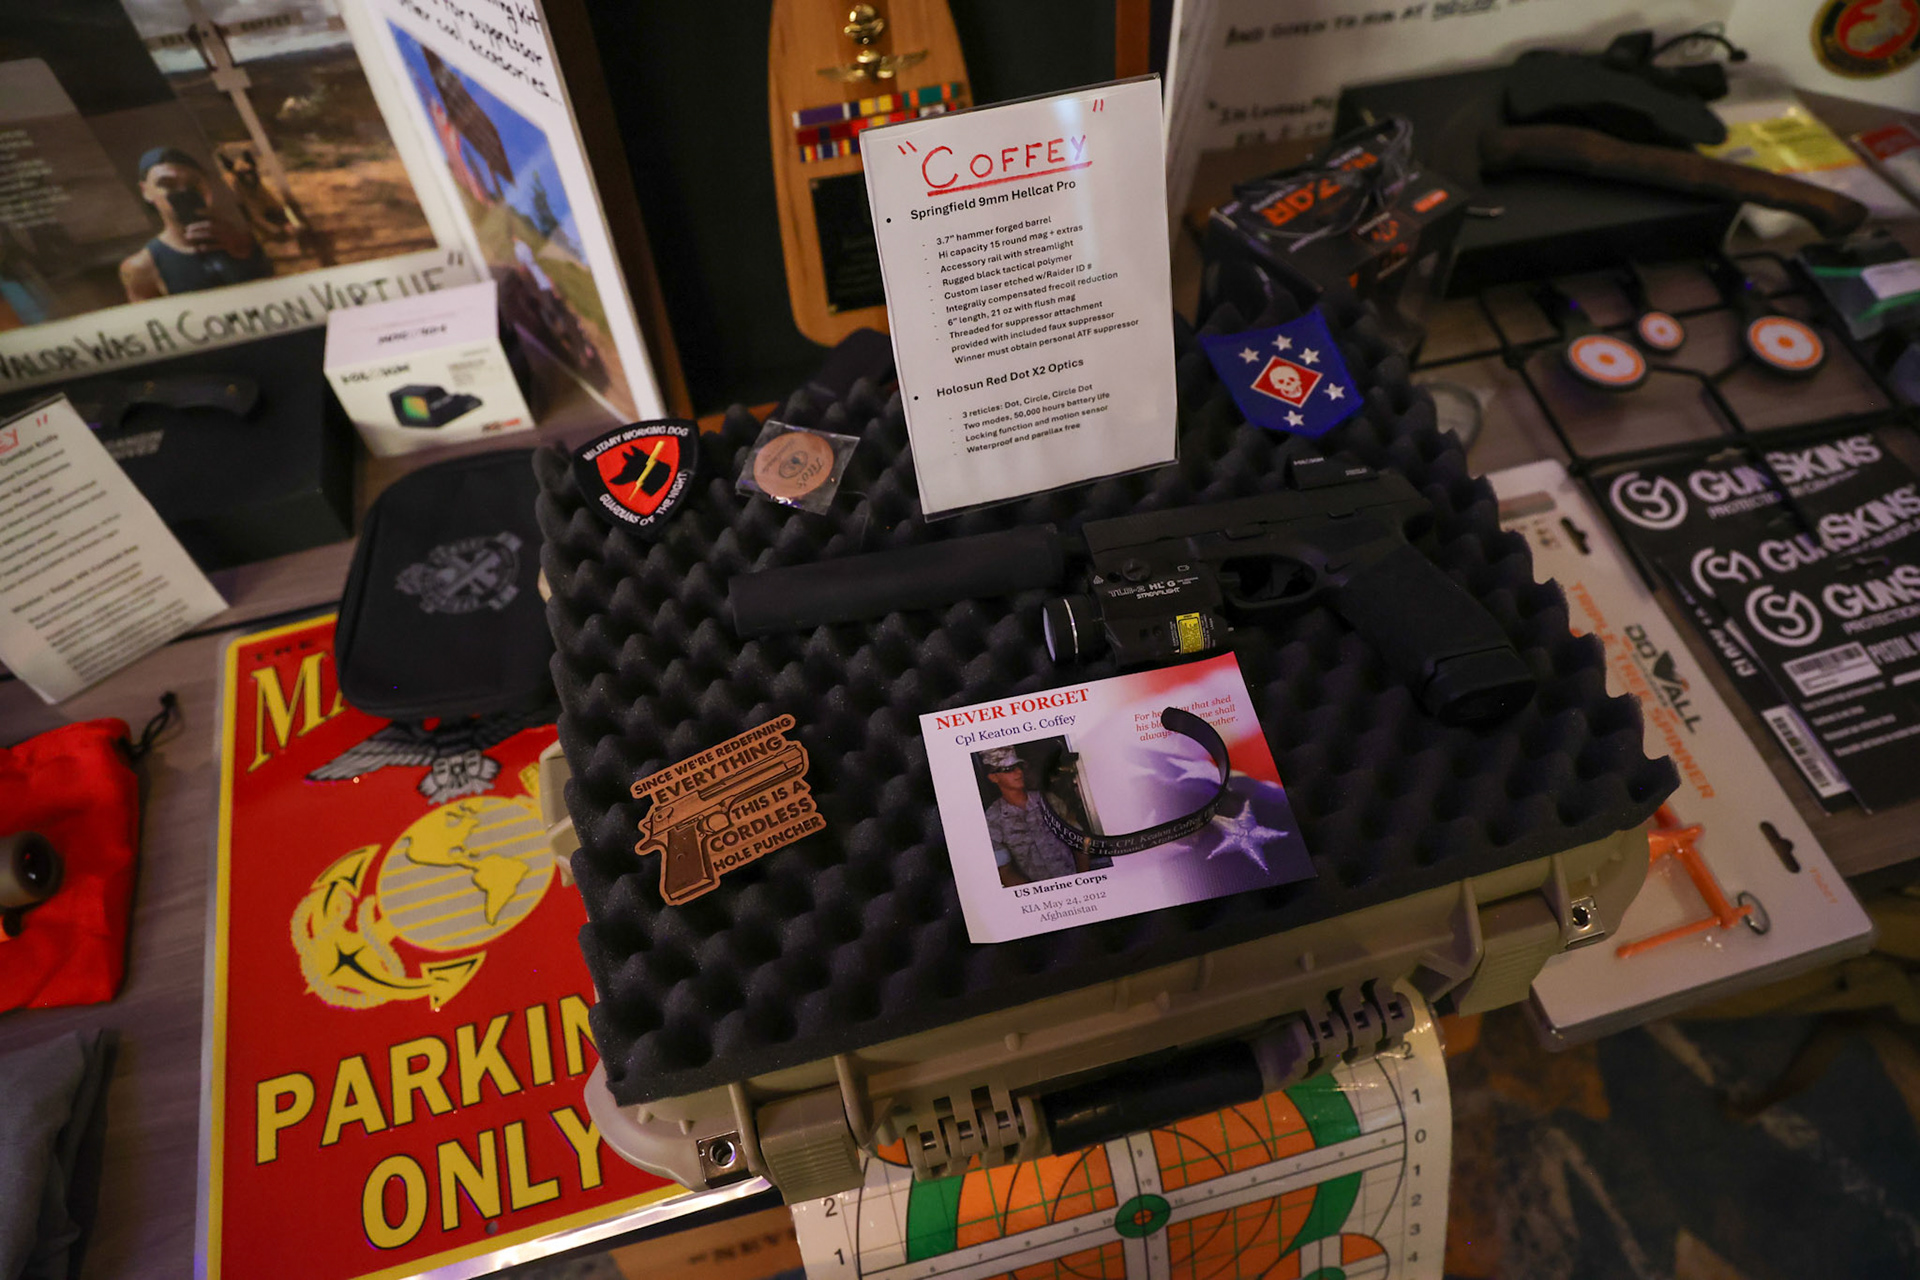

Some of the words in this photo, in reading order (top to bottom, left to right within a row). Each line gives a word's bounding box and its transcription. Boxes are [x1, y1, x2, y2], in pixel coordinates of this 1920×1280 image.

[910, 199, 977, 221] Springfield
[978, 195, 1010, 208] 9mm
[1012, 185, 1055, 201] Hellcat
[1057, 182, 1077, 192] Pro
[938, 250, 949, 260] Hi
[950, 245, 989, 258] capacity
[990, 240, 1001, 249] 15
[1002, 236, 1028, 247] round
[1029, 231, 1049, 241] mag
[1056, 226, 1084, 236] extras
[956, 230, 994, 242] hammer
[995, 222, 1024, 235] forged
[1025, 217, 1052, 229] barrel
[941, 259, 987, 274] Accessory
[988, 254, 1003, 264] rail
[1003, 251, 1023, 261] with
[1024, 241, 1074, 257] streamlight
[942, 274, 976, 287] Rugged
[976, 269, 1002, 280] black
[1002, 262, 1036, 275] tactical
[1037, 256, 1073, 269] polymer
[944, 288, 980, 301] Custom
[980, 283, 1003, 293] laser
[1004, 275, 1035, 288] etched
[1035, 269, 1075, 281] w/Raider
[1076, 264, 1086, 273] ID
[946, 300, 987, 314] Integrally
[988, 286, 1048, 305] compensated
[1077, 273, 1119, 286] reduction
[147, 320, 179, 351] A
[177, 299, 313, 344] COMMON
[949, 325, 991, 340] Threaded
[991, 322, 1004, 331] for
[1005, 313, 1053, 328] suppressor
[1054, 302, 1103, 318] attachment
[959, 313, 990, 324] length,
[991, 309, 1002, 318] 21
[1003, 307, 1013, 315] oz
[1014, 303, 1034, 313] with
[1034, 298, 1057, 308] flush
[1058, 294, 1077, 304] mag
[951, 339, 990, 354] provided
[990, 334, 1010, 344] with
[1010, 326, 1048, 340] included
[1049, 322, 1068, 332] faux
[1068, 313, 1115, 328] suppressor
[954, 354, 986, 365] Winner
[987, 348, 1010, 358] must
[1010, 342, 1038, 353] obtain
[1039, 333, 1077, 348] personal
[1077, 329, 1092, 339] ATF
[1093, 321, 1139, 335] suppressor
[937, 382, 984, 398] Holosun
[986, 375, 1008, 387] Red
[1010, 371, 1031, 382] Dot
[1032, 367, 1047, 377] X2
[1048, 360, 1085, 374] Optics
[962, 411, 969, 420] 3
[1004, 400, 1023, 410] Dot,
[1052, 389, 1077, 399] Circle
[1078, 384, 1094, 393] Dot
[963, 422, 981, 431] Two
[982, 416, 1013, 427] modes,
[1014, 408, 1042, 420] 50,000
[1042, 403, 1066, 413] hours
[1066, 397, 1097, 408] battery
[1097, 393, 1111, 401] life
[965, 431, 999, 443] Locking
[999, 423, 1034, 436] function
[1035, 418, 1051, 428] and
[1051, 412, 1081, 423] motion
[1081, 406, 1109, 417] sensor
[966, 438, 1014, 454] Waterproof
[1014, 434, 1031, 444] and
[1031, 428, 1064, 441] parallax
[1064, 423, 1081, 432] free
[582, 434, 623, 462] MILITARY
[621, 425, 667, 441] WORKING
[667, 425, 689, 438] DOG
[599, 493, 641, 524] GUARDIANS
[639, 515, 656, 526] OF
[655, 499, 676, 515] THE
[667, 471, 689, 500] NIGHT
[1757, 485, 1920, 572] GUSKINS
[935, 704, 1006, 732] NEVER
[1009, 687, 1090, 717] FORGET
[1134, 713, 1151, 723] For
[1191, 701, 1210, 711] that
[1211, 695, 1232, 707] shed
[1136, 723, 1150, 732] his
[1214, 704, 1237, 717] shall
[954, 732, 976, 747] Cpl
[978, 726, 1021, 742] Keaton
[1022, 721, 1037, 732] G.
[1038, 714, 1077, 730] Coffey
[1139, 729, 1172, 742] always
[1208, 716, 1240, 728] rother.
[634, 771, 673, 795] SINCE
[674, 754, 714, 777] WE'RE
[716, 717, 792, 758] REDEFINING
[654, 735, 783, 805] EVERYTHING
[1650, 707, 1716, 799] SPINNER
[731, 795, 770, 821] THIS
[772, 787, 789, 803] IS
[793, 780, 807, 795] A
[709, 797, 813, 853] CORDLESS
[1115, 837, 1136, 849] CPL
[1140, 828, 1172, 844] Keaton
[712, 848, 753, 873] HOLE
[754, 816, 822, 855] PUNCHER
[1013, 887, 1031, 899] US
[1032, 882, 1073, 895] Marine
[1074, 874, 1108, 887] Corps
[1020, 904, 1041, 915] KIA
[1043, 900, 1063, 911] May
[1065, 896, 1082, 906] 24,
[1083, 891, 1107, 903] 2012
[1039, 904, 1099, 923] Afghanistan
[256, 993, 603, 1167] PARKIN
[1411, 1088, 1422, 1104] 1
[1414, 1129, 1427, 1144] 0
[360, 1105, 606, 1251] ONLY
[1412, 1164, 1422, 1176] 1
[823, 1197, 839, 1219] 2
[1411, 1195, 1422, 1208] 2
[833, 1247, 846, 1267] 1
